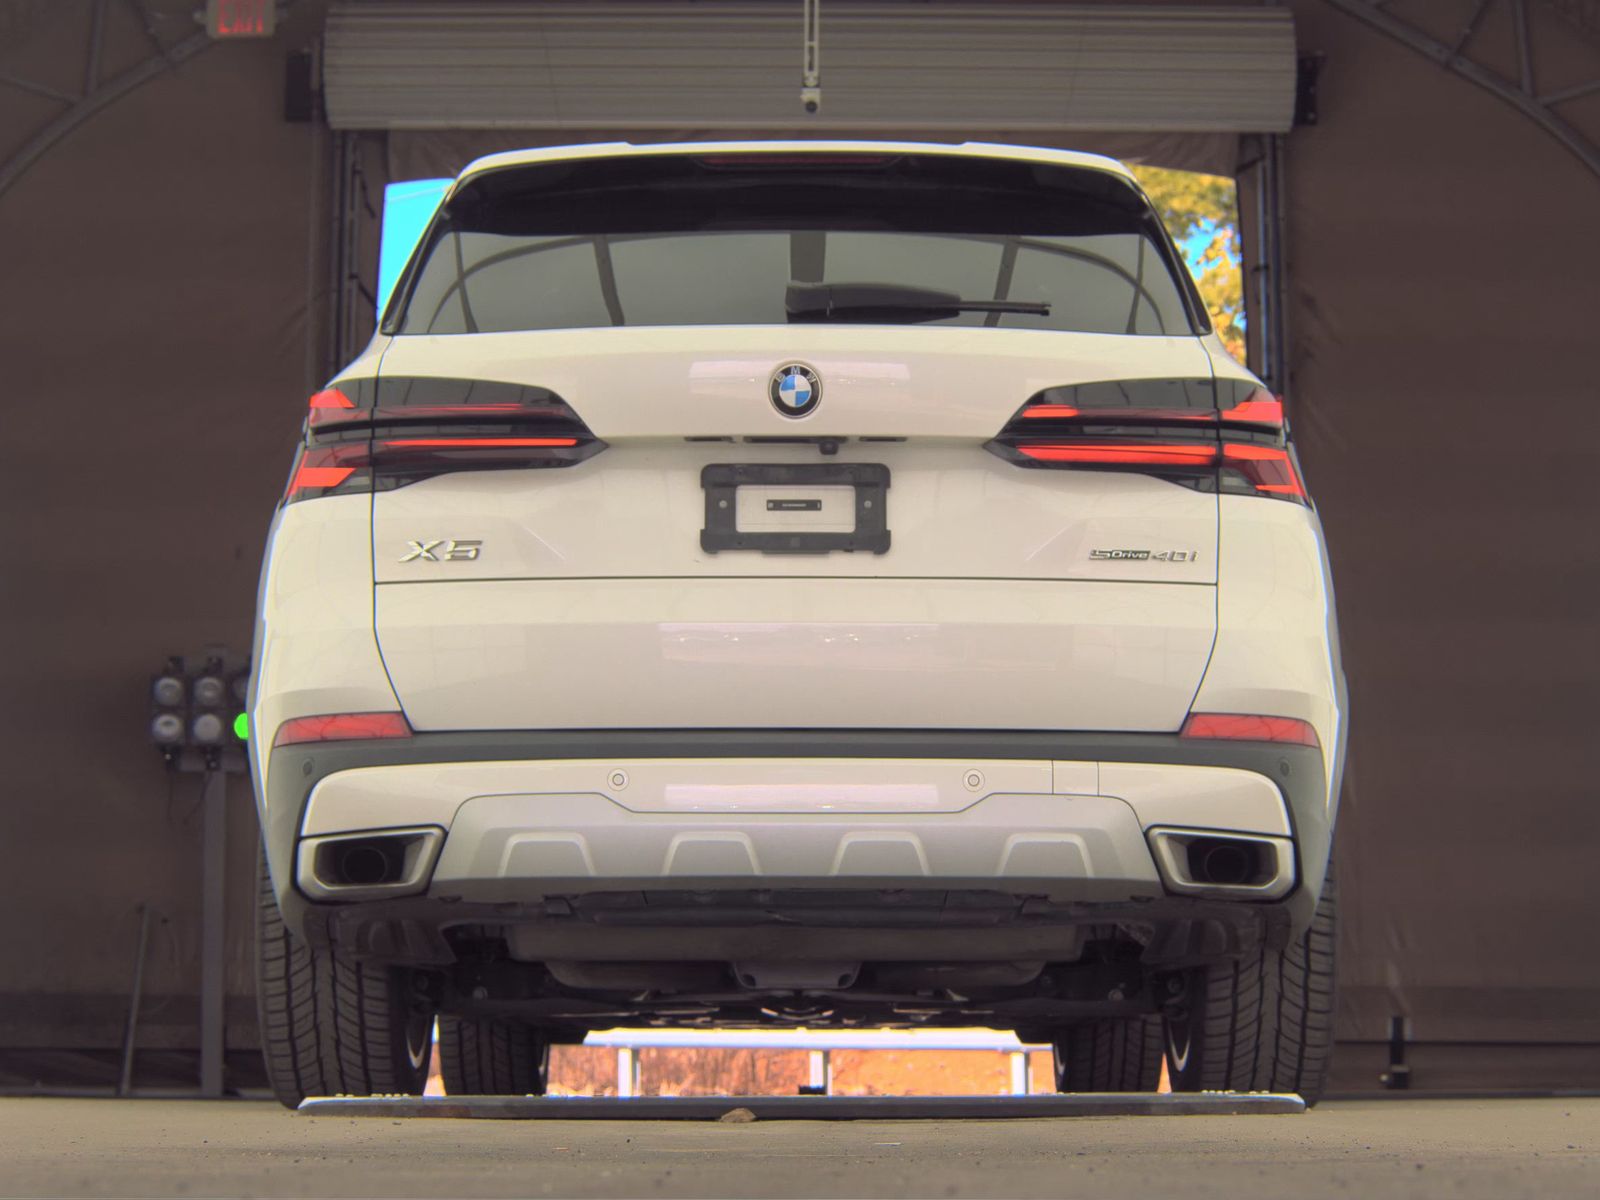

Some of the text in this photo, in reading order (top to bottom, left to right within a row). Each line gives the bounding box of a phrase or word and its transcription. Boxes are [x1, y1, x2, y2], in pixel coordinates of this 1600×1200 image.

[217, 0, 265, 33] EXIT
[775, 365, 817, 383] BMW
[398, 539, 482, 563] X5
[1152, 551, 1198, 562] 40i
